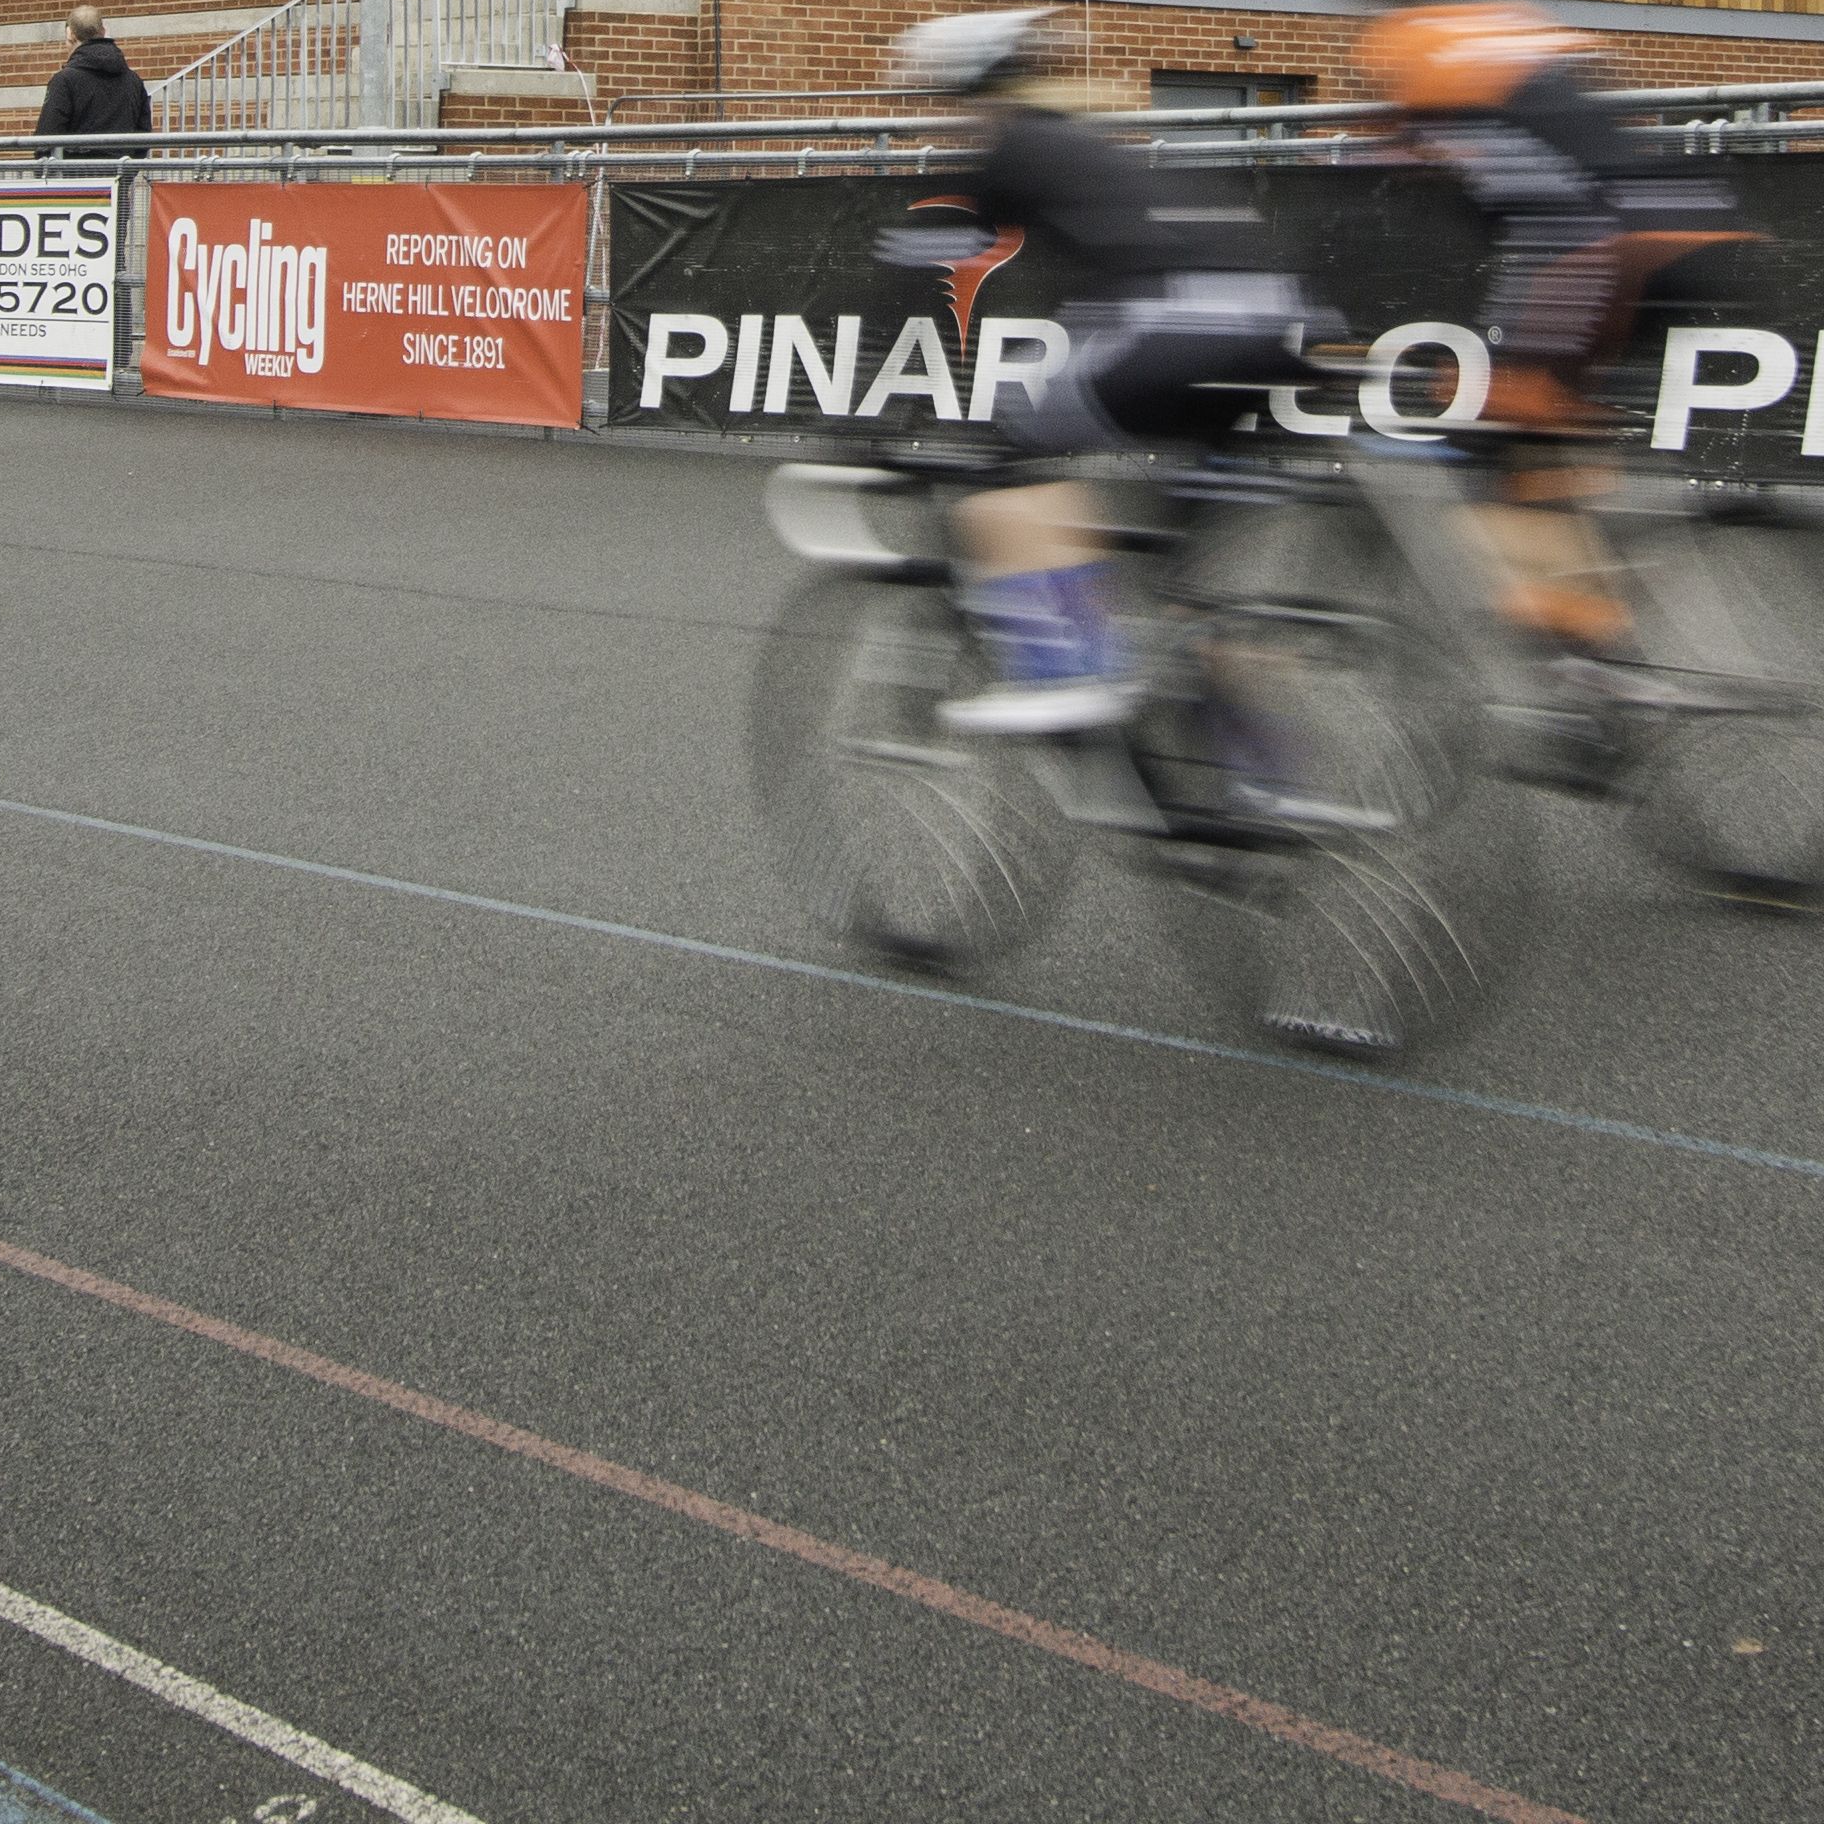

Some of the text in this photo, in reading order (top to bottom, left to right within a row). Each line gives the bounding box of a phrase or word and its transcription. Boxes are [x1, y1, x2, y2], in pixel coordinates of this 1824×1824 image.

[386, 234, 527, 269] REPORTING ON
[30, 263, 56, 277] SE5
[167, 217, 328, 374] Cycling
[342, 281, 572, 321] HERNE HILL VELODROME
[0, 323, 47, 338] NEEDS
[244, 353, 294, 378] WEEKLY
[402, 332, 506, 369] SINCE 1891
